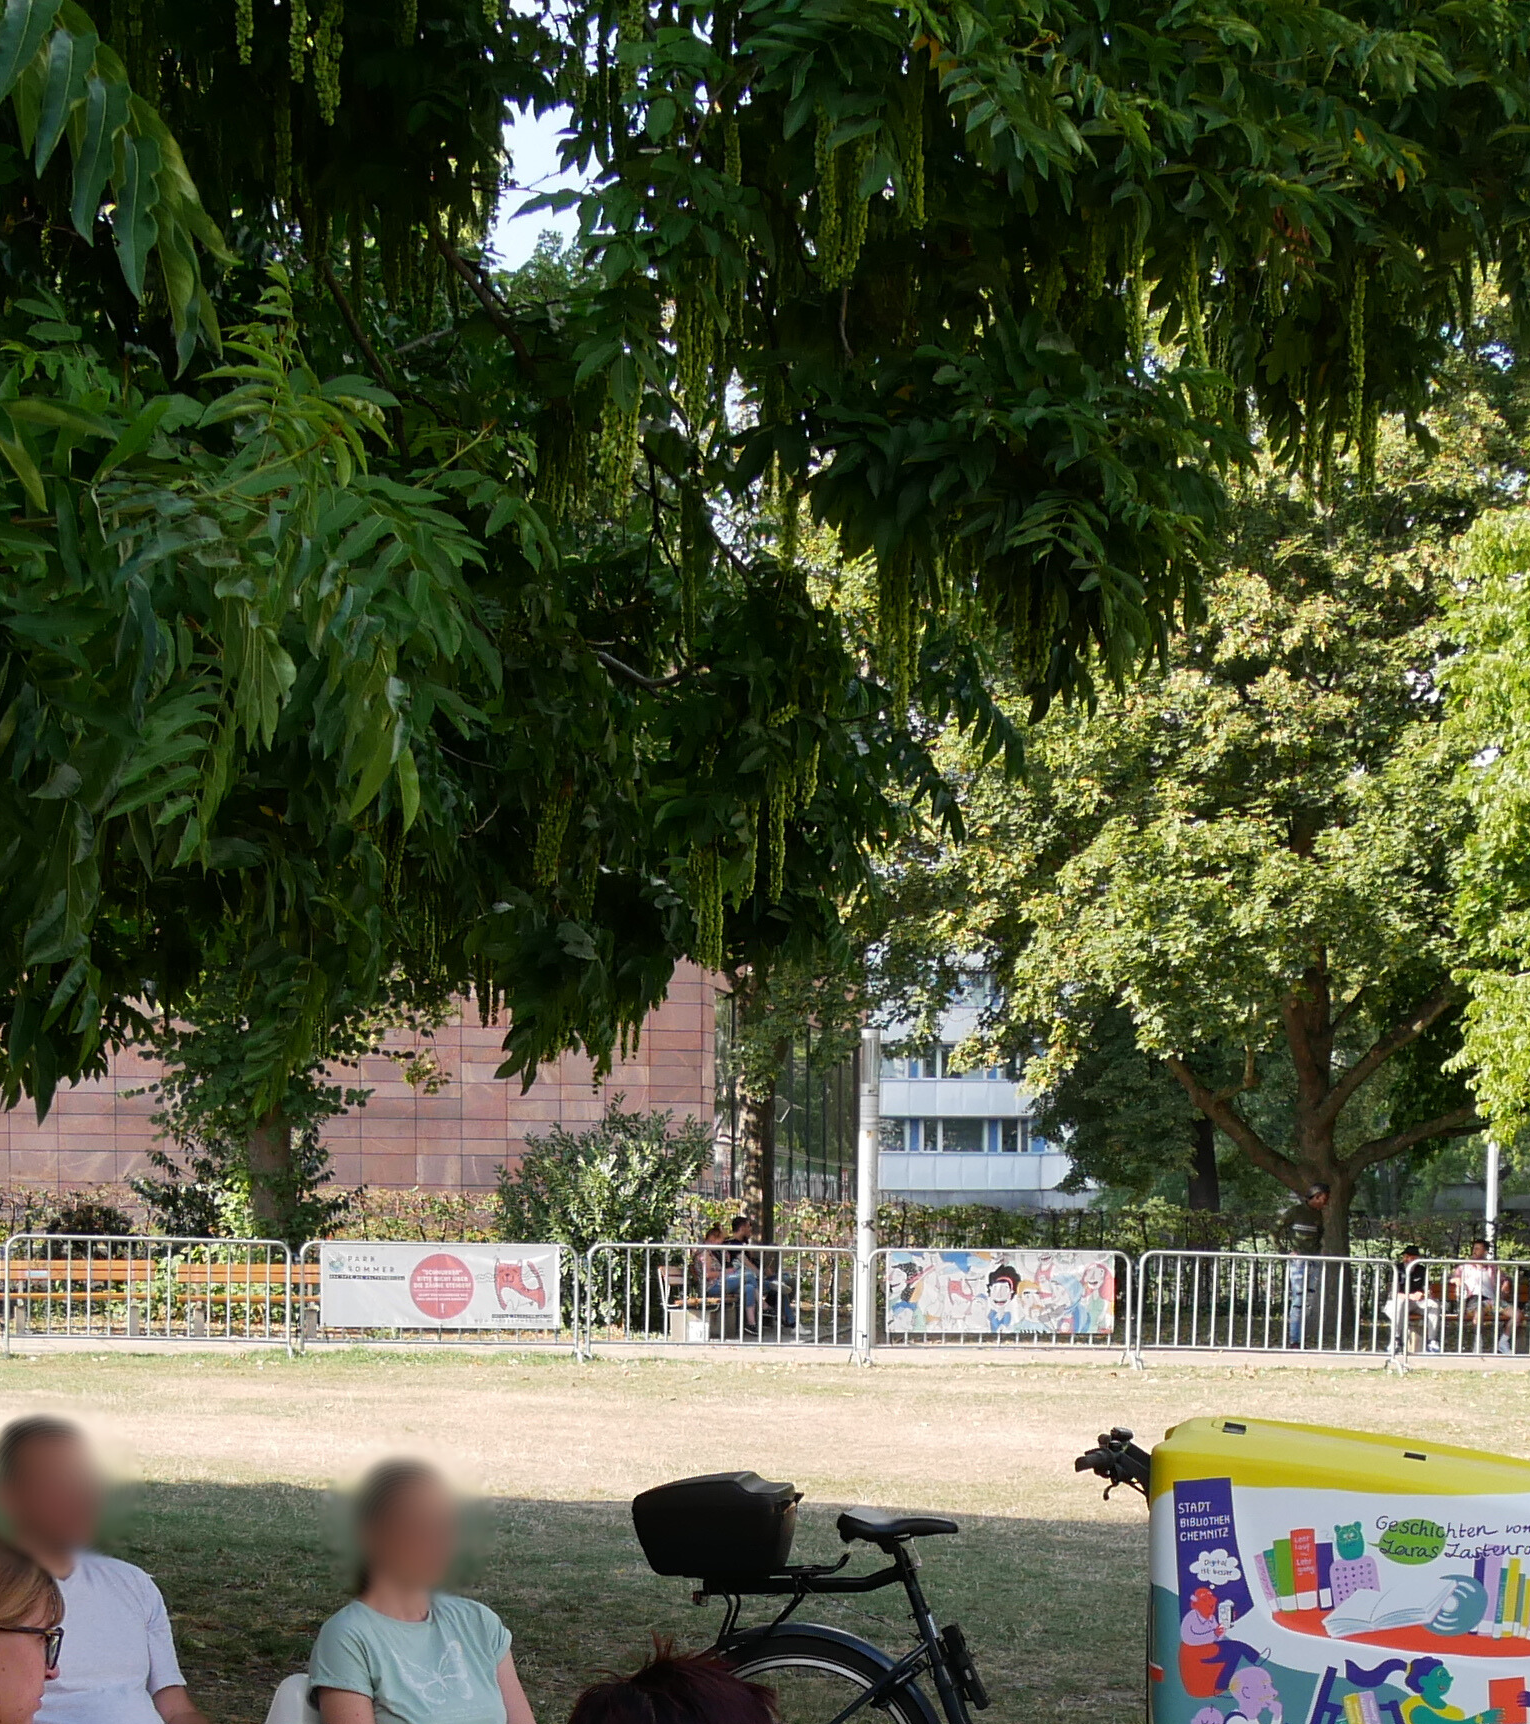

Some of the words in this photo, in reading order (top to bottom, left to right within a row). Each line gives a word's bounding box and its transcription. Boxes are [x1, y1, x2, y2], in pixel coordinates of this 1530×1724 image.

[1178, 1501, 1211, 1514] STADT
[1180, 1514, 1231, 1528] BIBLIOTHEK
[1375, 1515, 1498, 1538] Geschichten
[1180, 1527, 1229, 1542] CHEMNITZ
